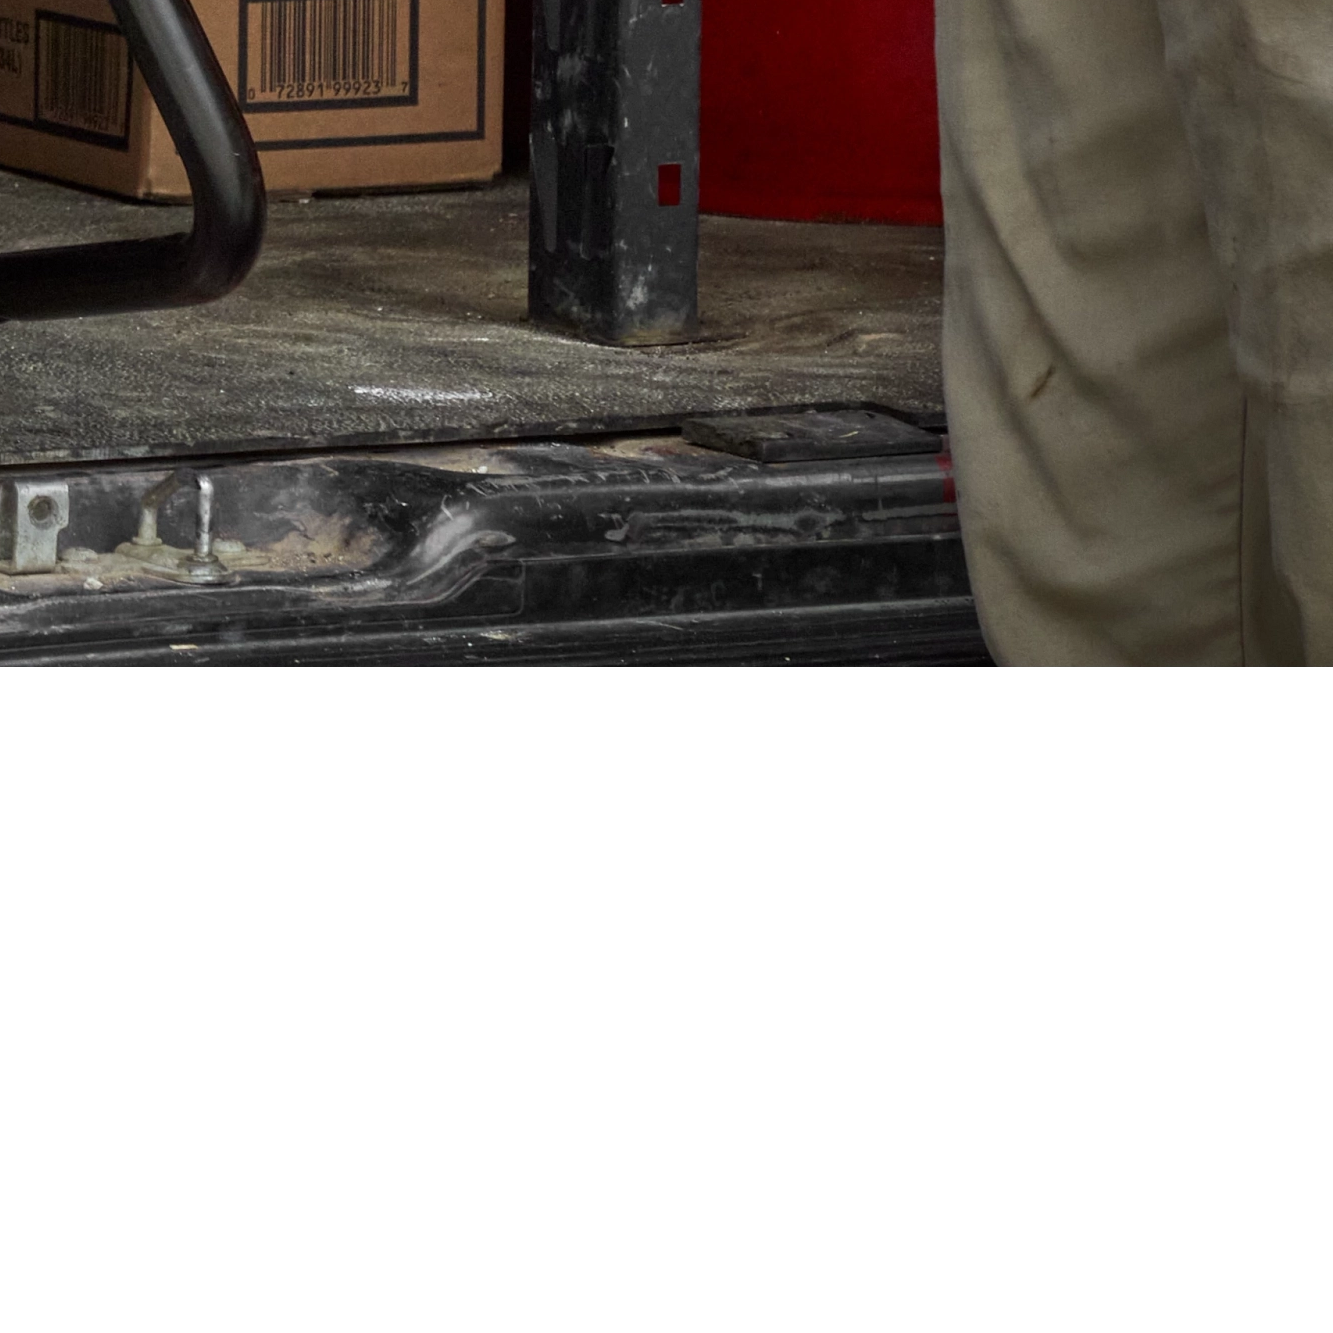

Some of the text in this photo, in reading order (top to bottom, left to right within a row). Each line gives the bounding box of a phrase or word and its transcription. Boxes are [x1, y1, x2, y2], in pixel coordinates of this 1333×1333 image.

[248, 79, 409, 100] 0 72891 99923 7
